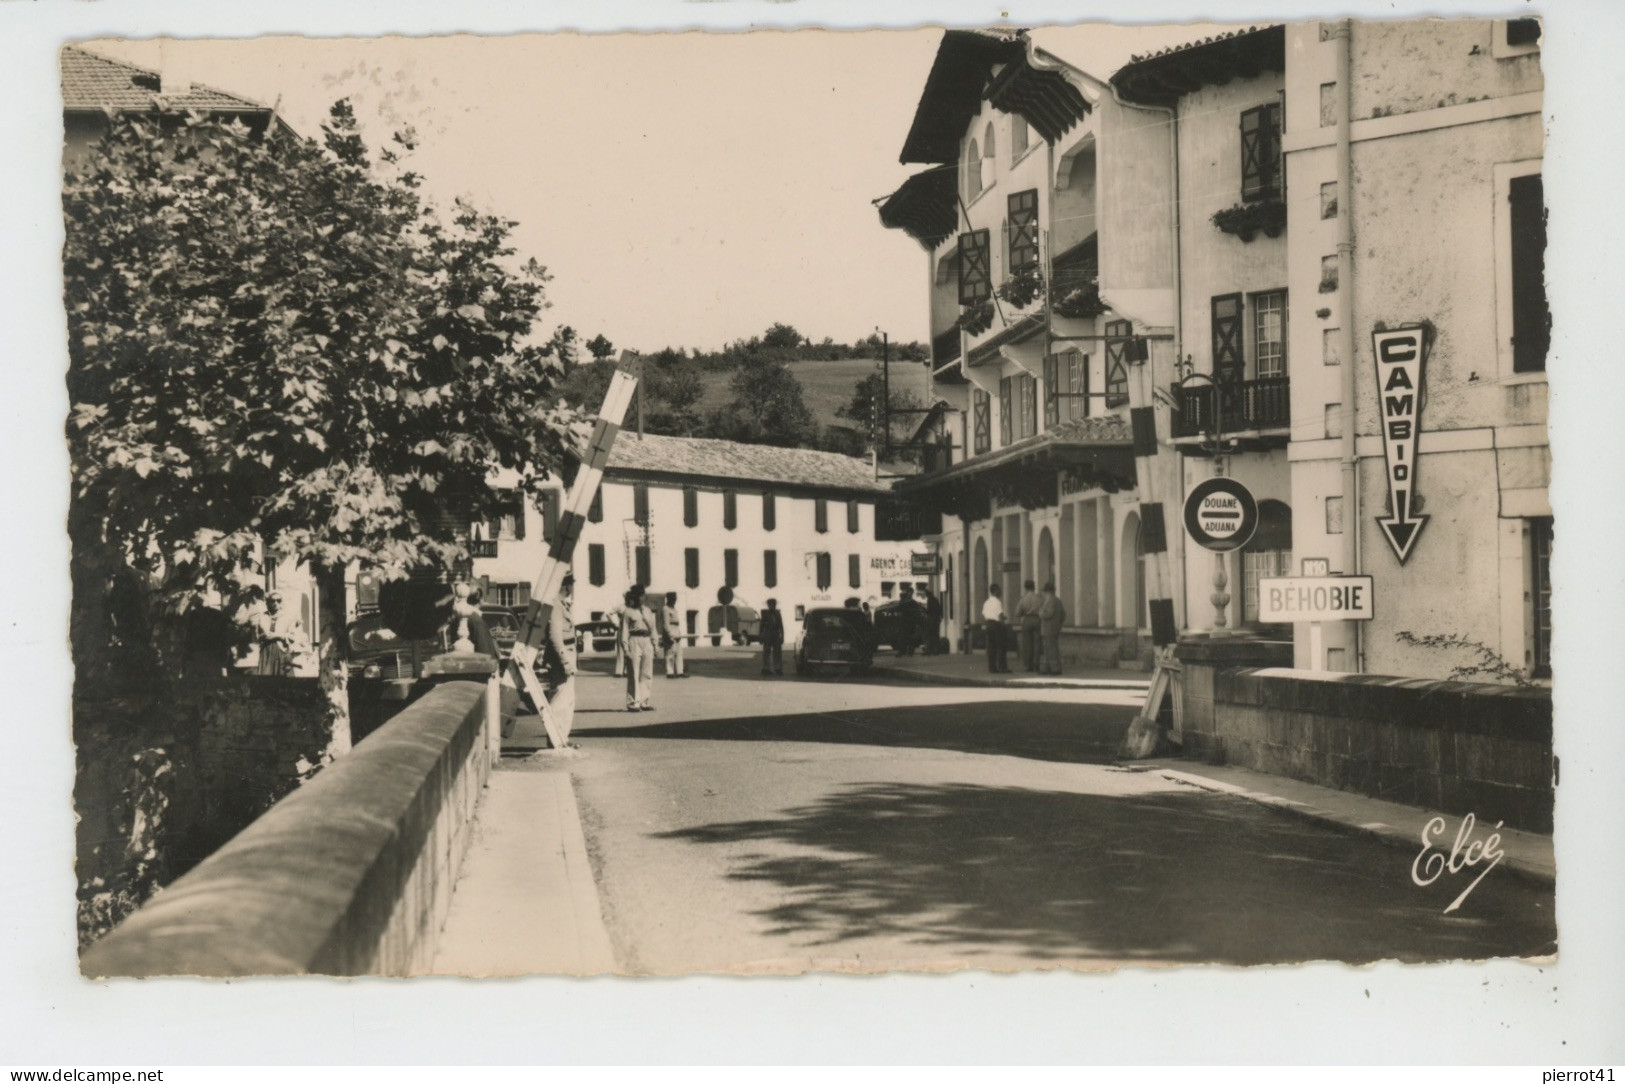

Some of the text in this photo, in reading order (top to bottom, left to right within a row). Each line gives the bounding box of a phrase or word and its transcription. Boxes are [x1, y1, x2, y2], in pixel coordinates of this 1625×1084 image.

[1380, 336, 1417, 481] CAMBIO
[1204, 498, 1238, 509] DOUANE
[1204, 522, 1236, 532] ADUANA
[870, 558, 895, 569] AGENCE
